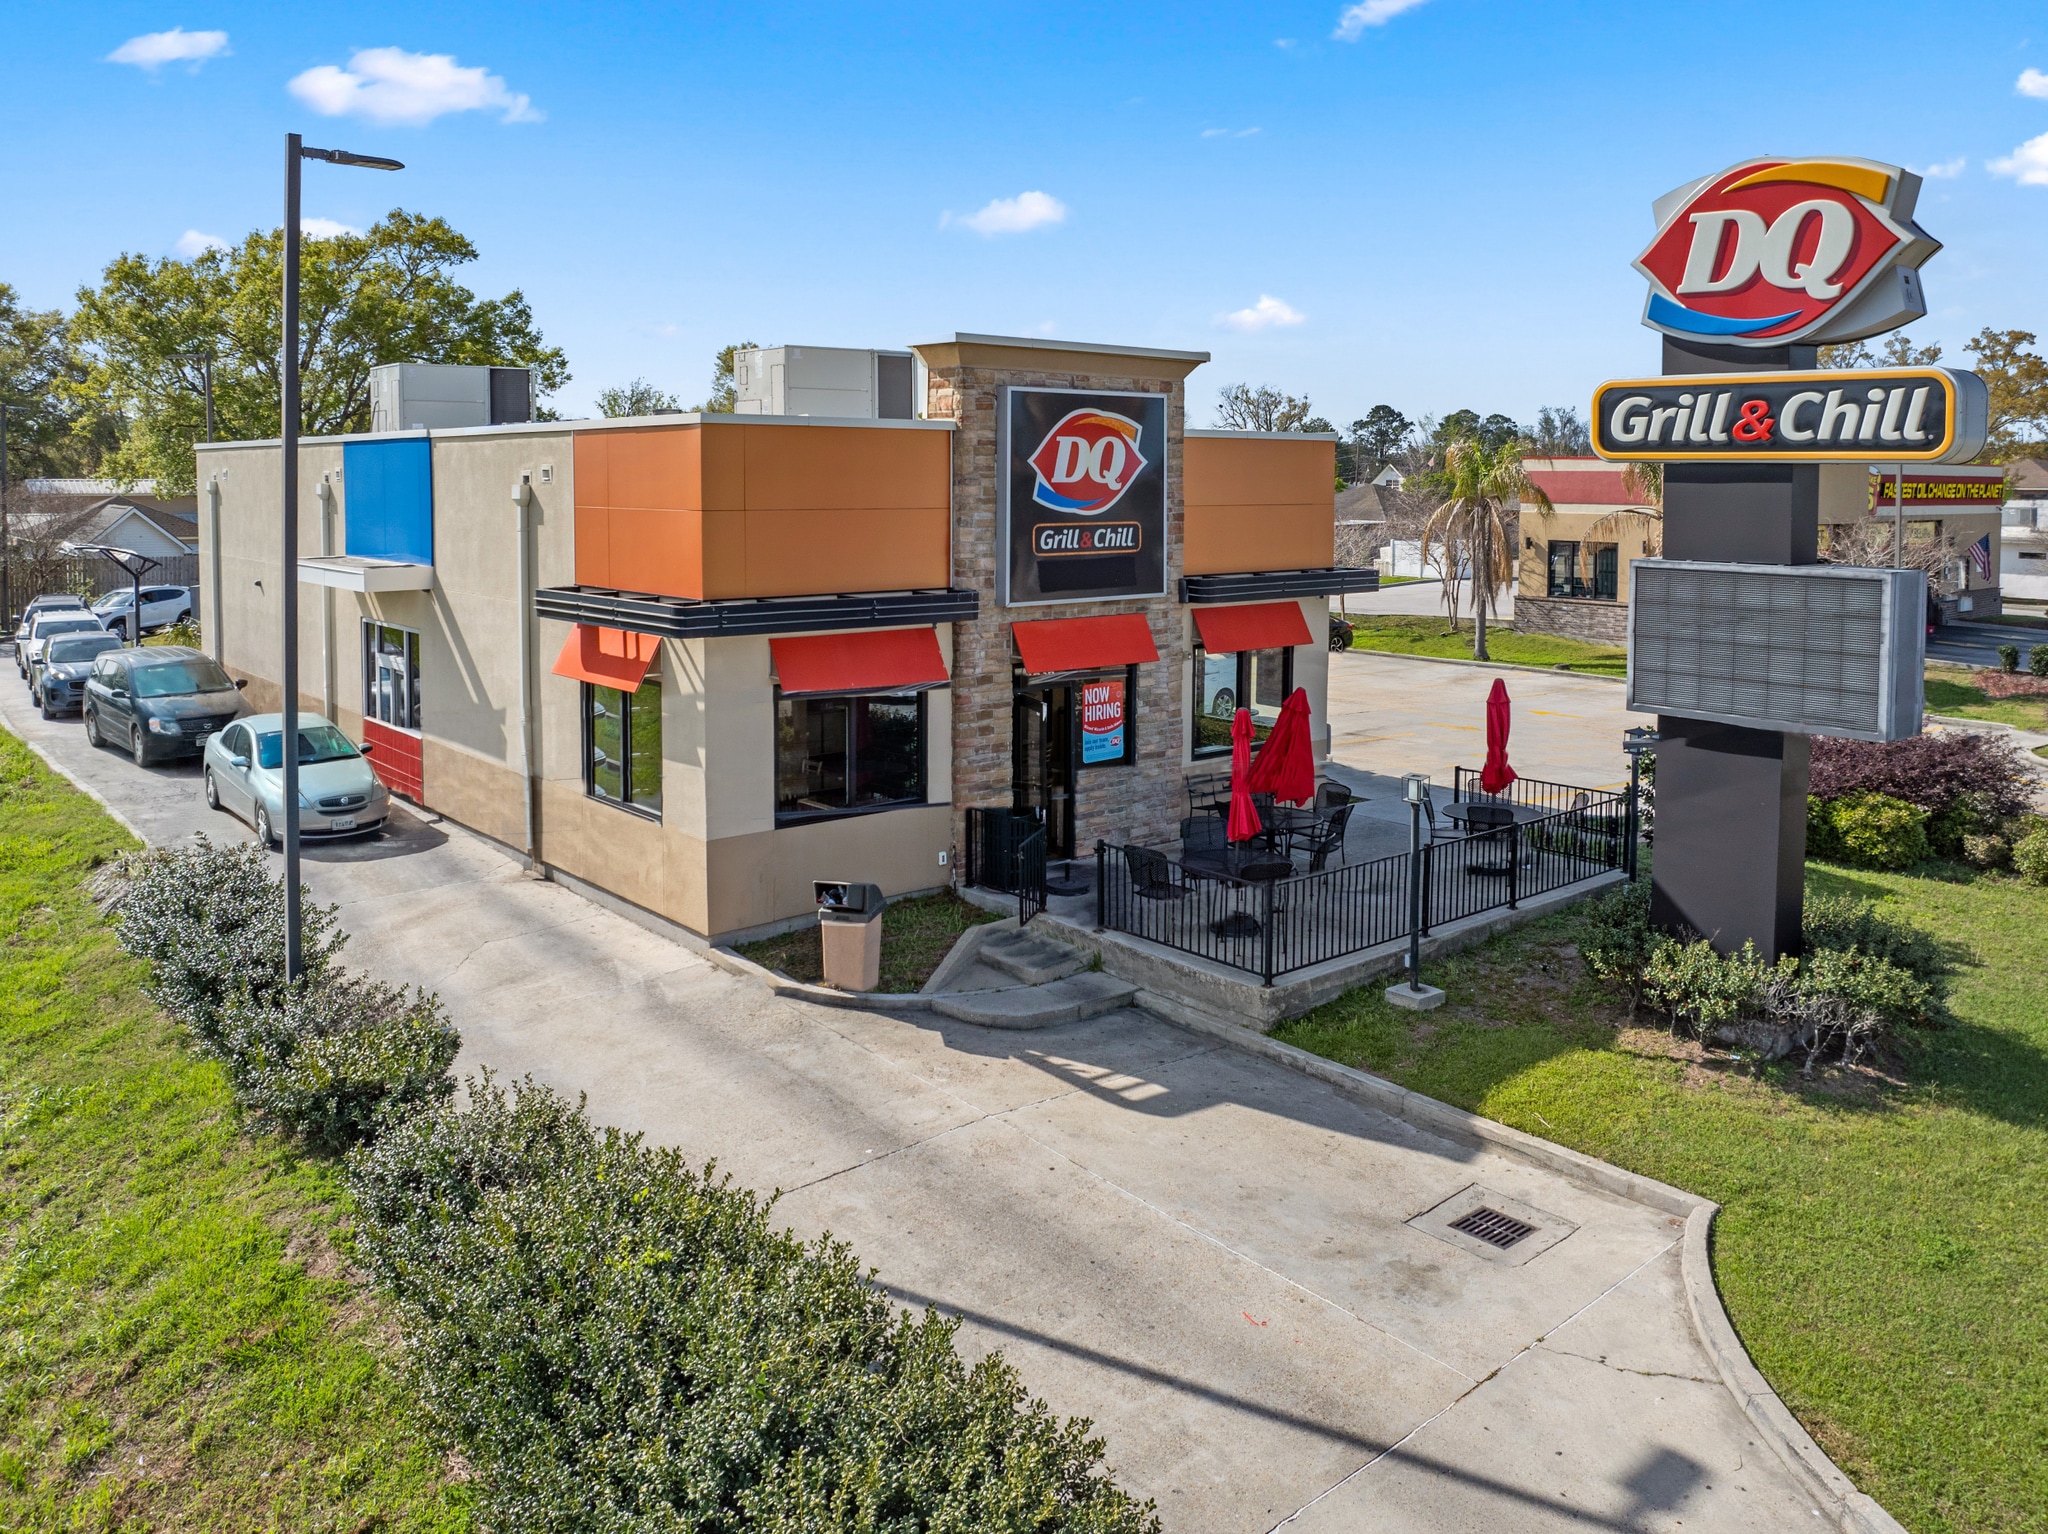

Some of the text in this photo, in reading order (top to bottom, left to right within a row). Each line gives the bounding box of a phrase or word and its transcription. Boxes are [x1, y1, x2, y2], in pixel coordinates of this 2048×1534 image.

[1676, 199, 1854, 300] DQ
[1611, 387, 1930, 443] Grill & Chill
[1051, 436, 1126, 490] DQ
[1884, 482, 2003, 499] FASEST OIL CHANGE ON THE PLANET
[1040, 527, 1133, 550] Grill & Chill
[1085, 686, 1110, 705] NOW
[1085, 702, 1121, 722] HIRING
